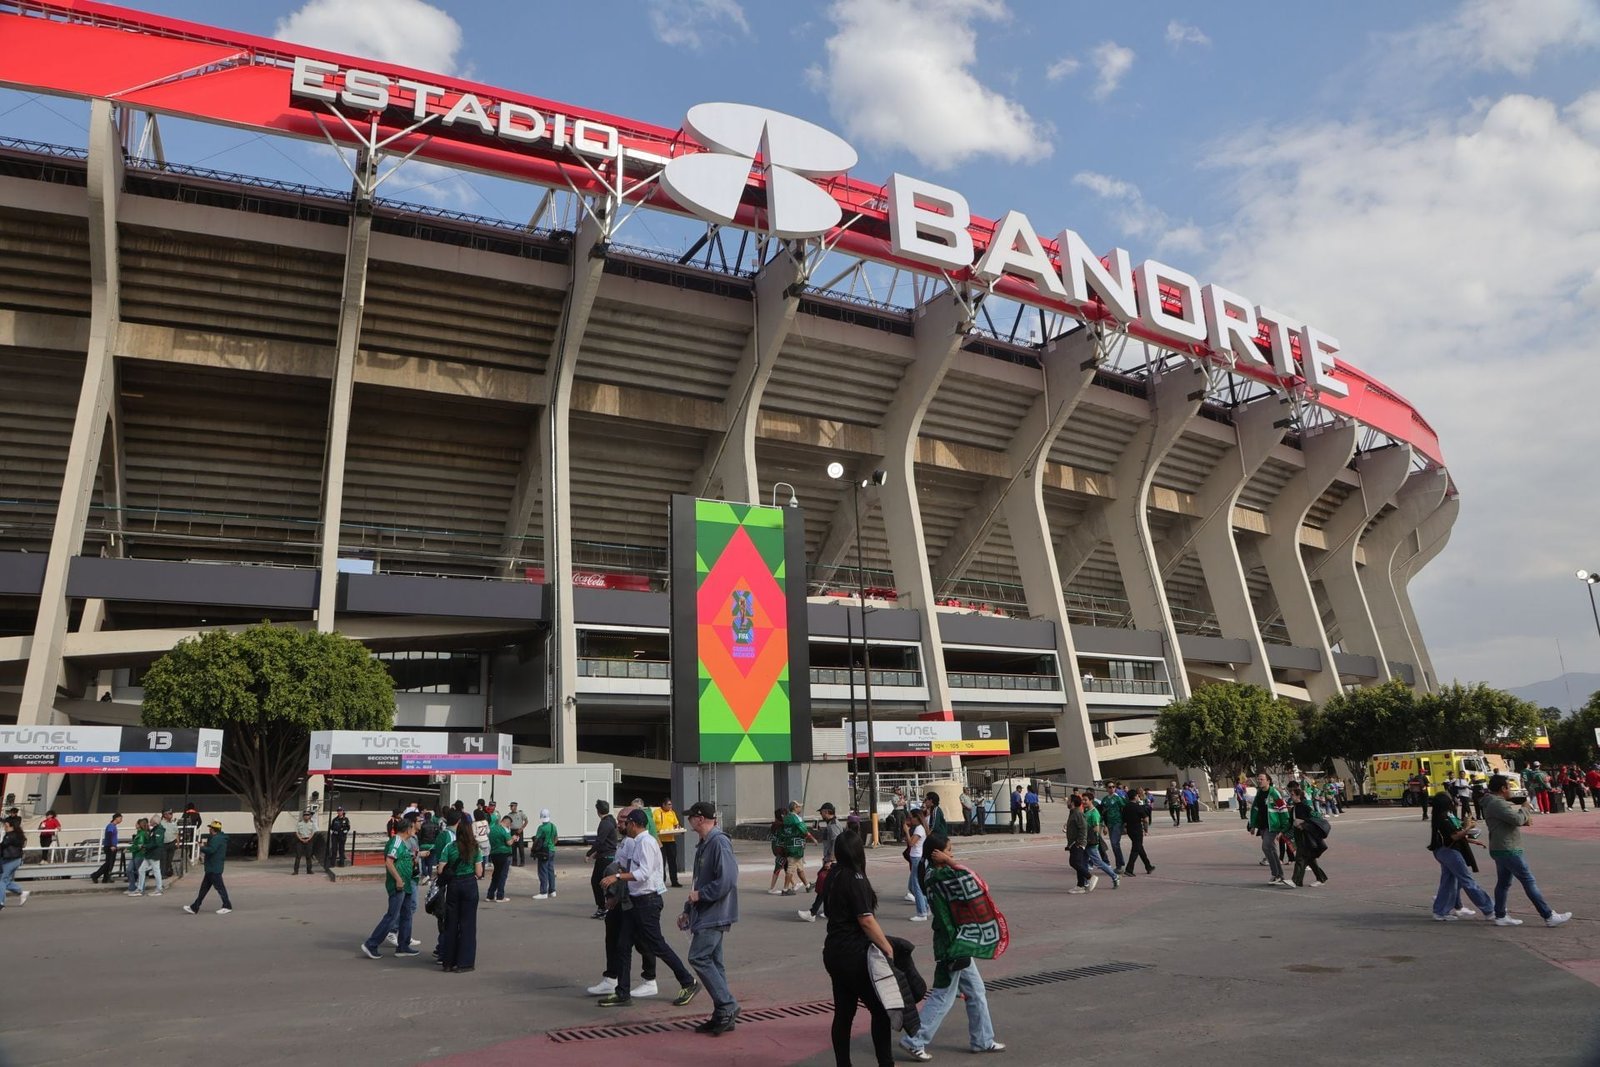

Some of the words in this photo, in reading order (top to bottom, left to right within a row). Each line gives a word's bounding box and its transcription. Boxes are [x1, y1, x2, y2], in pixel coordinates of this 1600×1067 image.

[292, 56, 619, 157] ESTADIO
[887, 172, 1349, 398] BANORTE
[977, 725, 992, 738] 15
[147, 731, 173, 750] 13
[203, 740, 220, 757] 13
[463, 737, 484, 752] 14
[64, 755, 83, 763] B01
[102, 755, 120, 763] B15
[314, 744, 331, 760] 14
